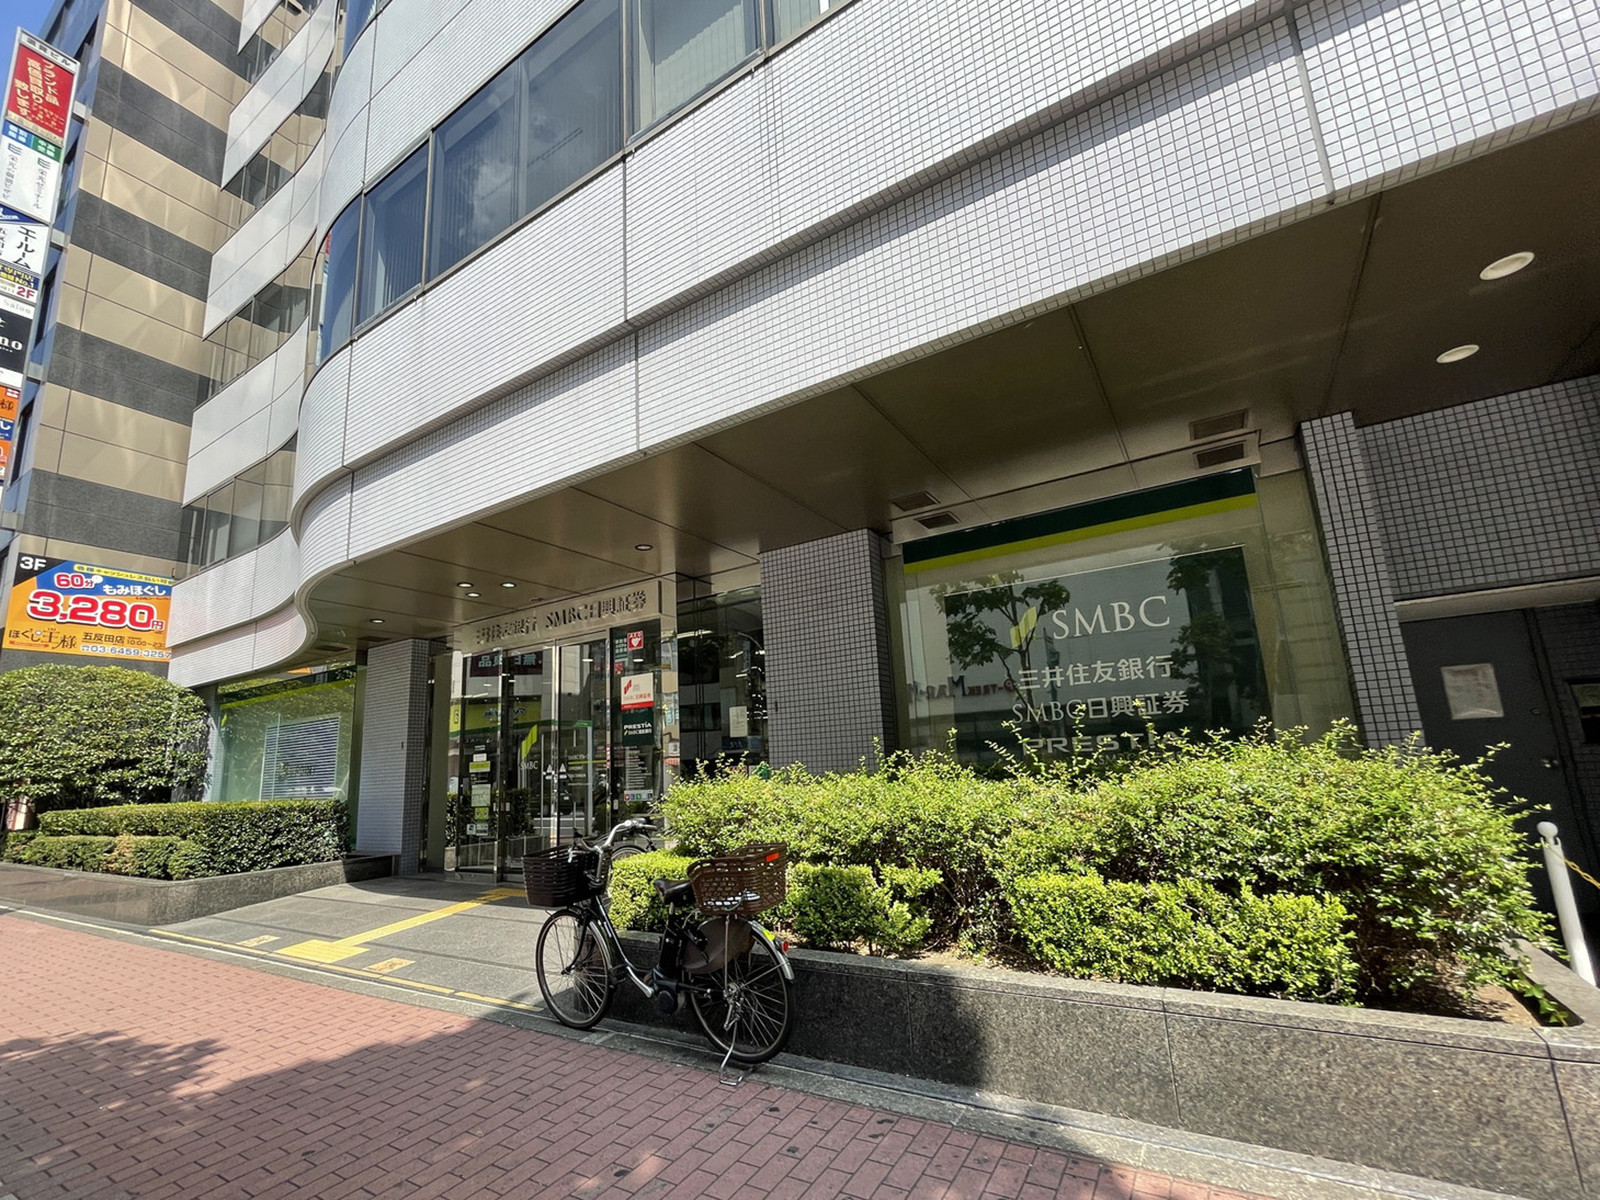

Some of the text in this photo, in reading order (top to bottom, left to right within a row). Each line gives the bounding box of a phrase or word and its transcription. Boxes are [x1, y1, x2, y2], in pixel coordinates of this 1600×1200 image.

[17, 285, 35, 299] 2F
[20, 556, 47, 571] 3F
[55, 573, 94, 588] 60分
[103, 585, 166, 596] もみほぐし
[28, 590, 164, 630] 3,280円
[1052, 596, 1170, 640] SMBC
[83, 632, 125, 644] 五反田店
[1018, 655, 1174, 690] 三井住友銀行
[1012, 691, 1189, 723] SMBC日興証券
[520, 760, 539, 770] SMBC
